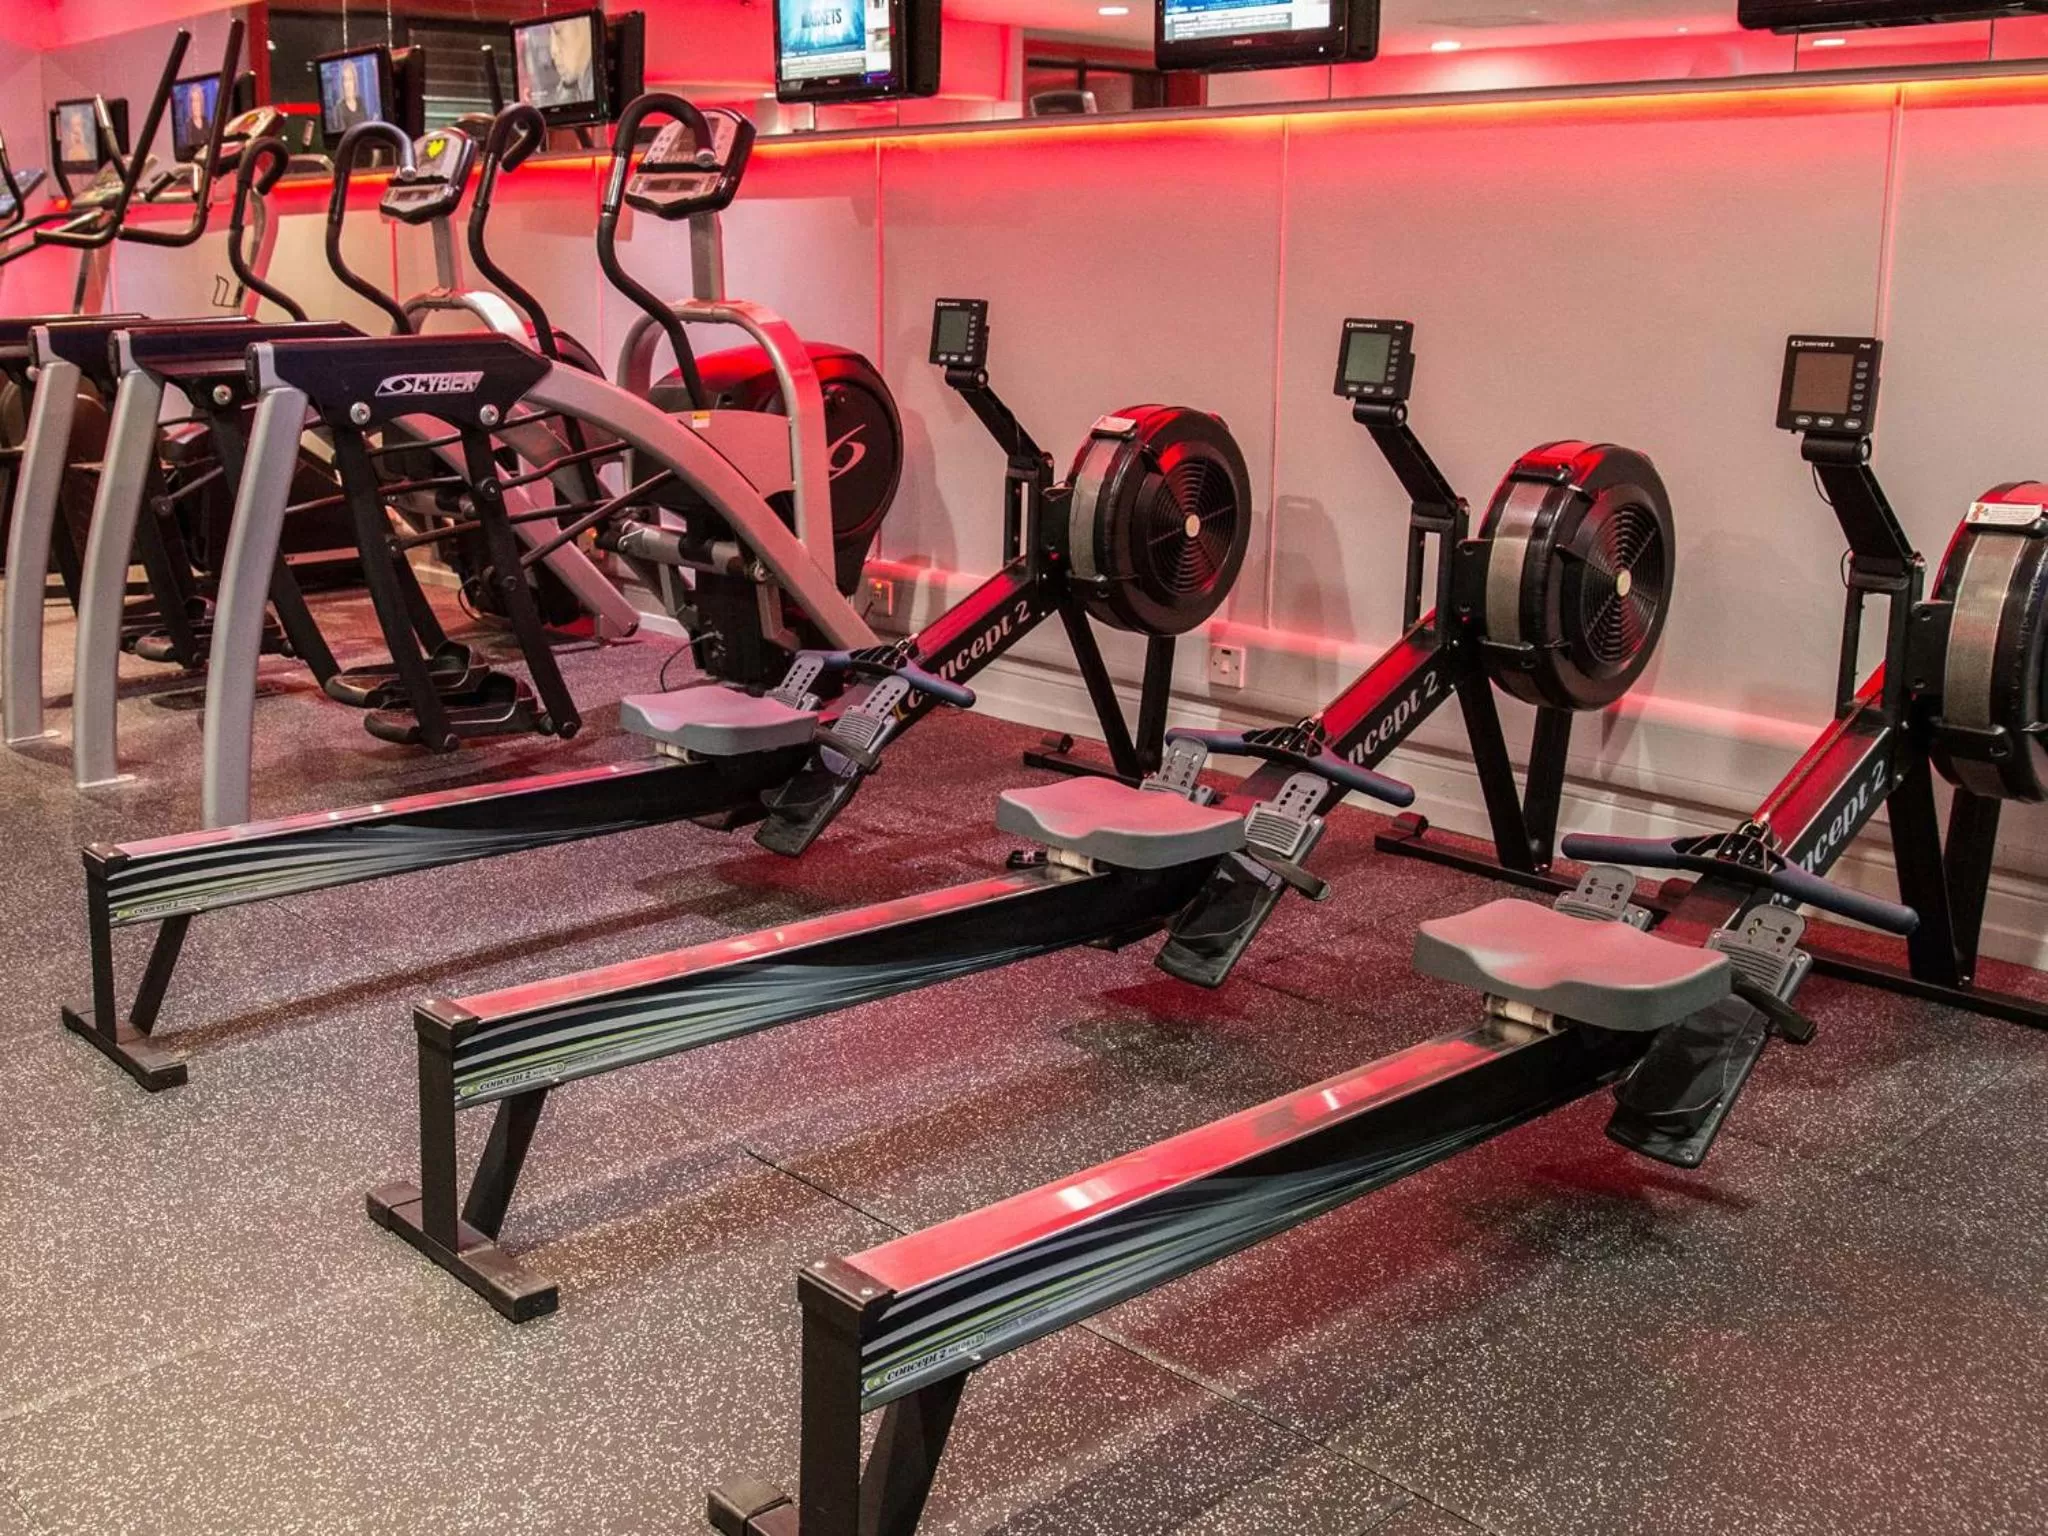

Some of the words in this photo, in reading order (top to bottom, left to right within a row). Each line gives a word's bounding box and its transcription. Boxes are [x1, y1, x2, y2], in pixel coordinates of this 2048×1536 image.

[413, 375, 476, 393] CYBEX
[907, 615, 1012, 709] cncept
[1014, 600, 1031, 624] 2
[1348, 689, 1421, 764] ncept
[1423, 670, 1440, 699] 2
[1872, 760, 1886, 793] 2
